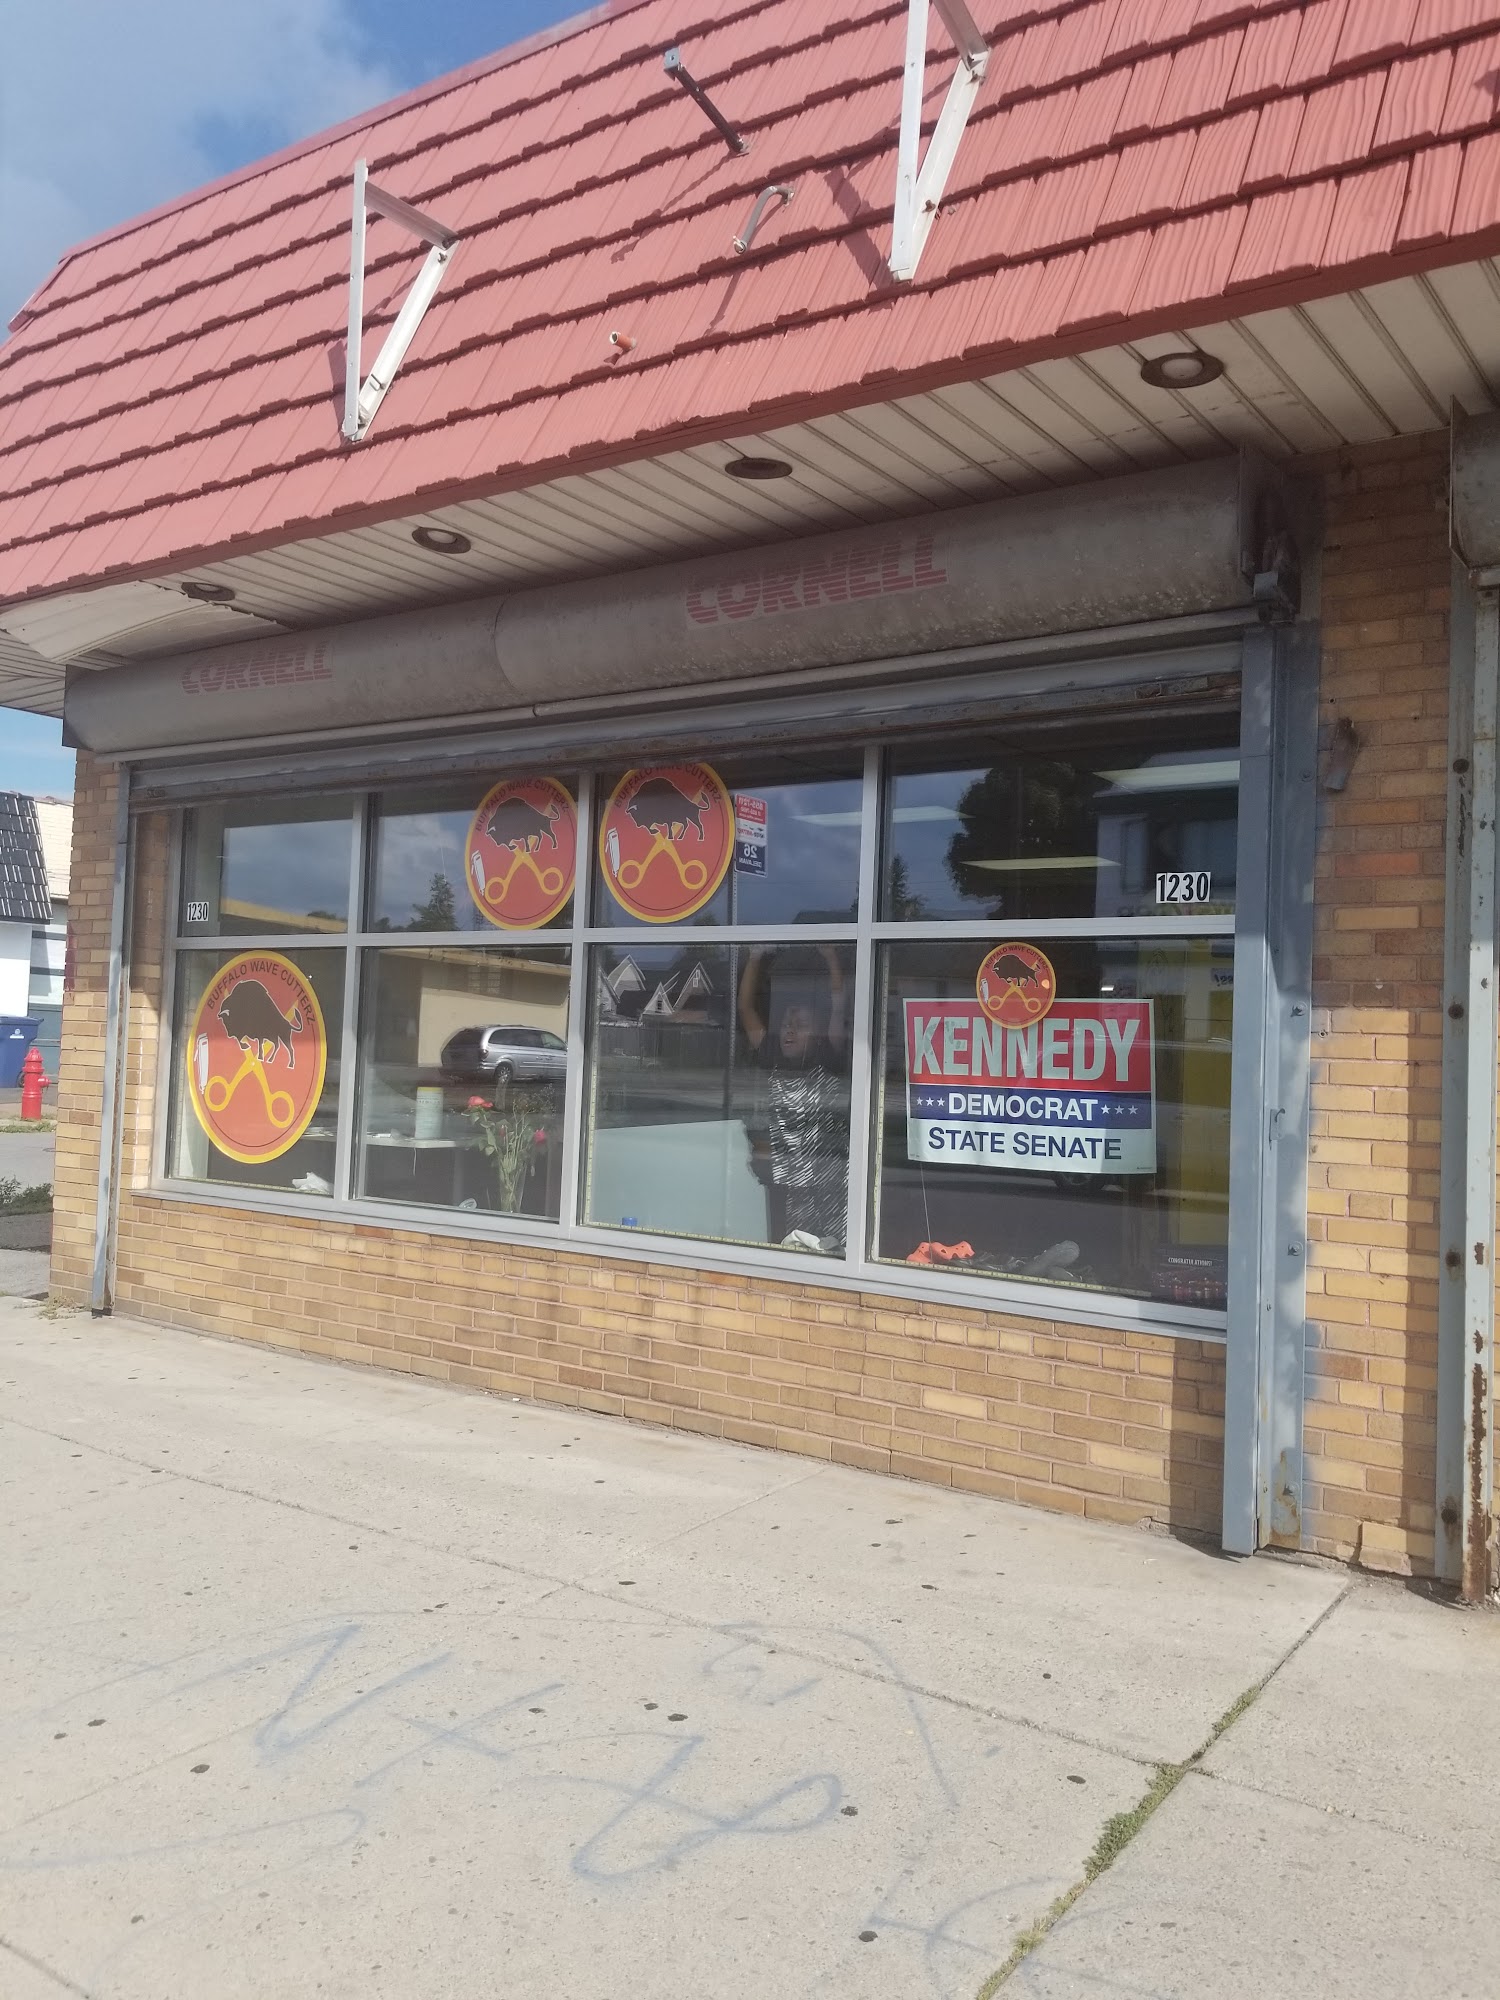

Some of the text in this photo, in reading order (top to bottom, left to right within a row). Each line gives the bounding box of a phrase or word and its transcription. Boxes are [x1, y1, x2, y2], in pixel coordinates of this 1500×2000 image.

[687, 532, 948, 626] CORNELL
[181, 642, 332, 696] CORNELL
[475, 778, 570, 832] BUFFALO WAVE CUTTERZ
[614, 763, 722, 808] BUFFALO CUTTERZ
[1158, 872, 1209, 902] 1230
[187, 902, 208, 922] 1230
[985, 947, 1008, 969] BUFFALO
[207, 960, 316, 1026] BUFFALO WAVE CUTTERZ
[913, 1014, 1141, 1083] KENNEDY
[947, 1091, 1099, 1122] DEMOCRAT
[928, 1124, 1123, 1161] STATE SENATE
